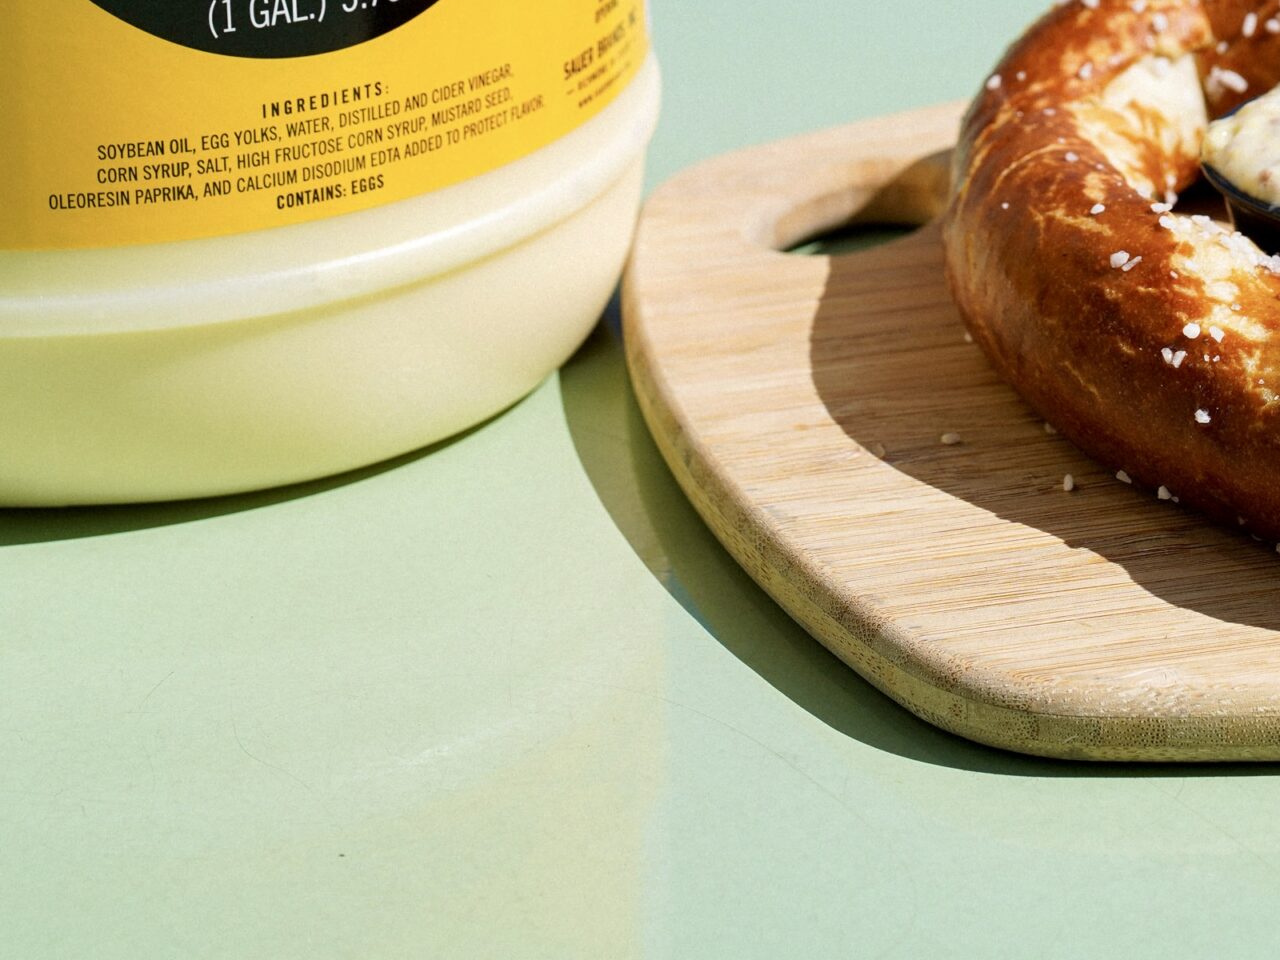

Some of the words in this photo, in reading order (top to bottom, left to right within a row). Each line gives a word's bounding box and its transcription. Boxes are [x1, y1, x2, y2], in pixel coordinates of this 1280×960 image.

[97, 140, 165, 160] SOYBEAN
[169, 138, 196, 154] OIL,
[201, 132, 230, 151] EGG
[234, 126, 282, 146] YOLKS,
[286, 117, 334, 138] WATER,
[339, 100, 400, 128] DISTILLED
[404, 92, 428, 113] AND
[431, 80, 465, 104] CIDER
[262, 81, 389, 119] INGREDIENTS:
[48, 190, 130, 210] OLEORESIN
[135, 184, 198, 204] PAPRIKA,
[203, 179, 231, 198] AND
[236, 169, 298, 193] CALCIUM
[302, 155, 366, 182] DISODIUM
[370, 147, 401, 167] EDTA
[404, 134, 443, 158] ADDED
[445, 128, 460, 145] TO
[463, 110, 508, 140] PROTECT
[97, 166, 138, 184] CORN
[143, 161, 192, 180] SYRUP,
[196, 156, 232, 174] SALT,
[237, 150, 270, 170] HIGH
[275, 136, 343, 163] FRUCTOSE
[347, 128, 383, 149] CORN
[387, 116, 428, 140] SYRUP,
[431, 98, 482, 127] MUSTARD
[277, 184, 346, 209] CONTAINS:
[351, 174, 385, 195] EGGS
